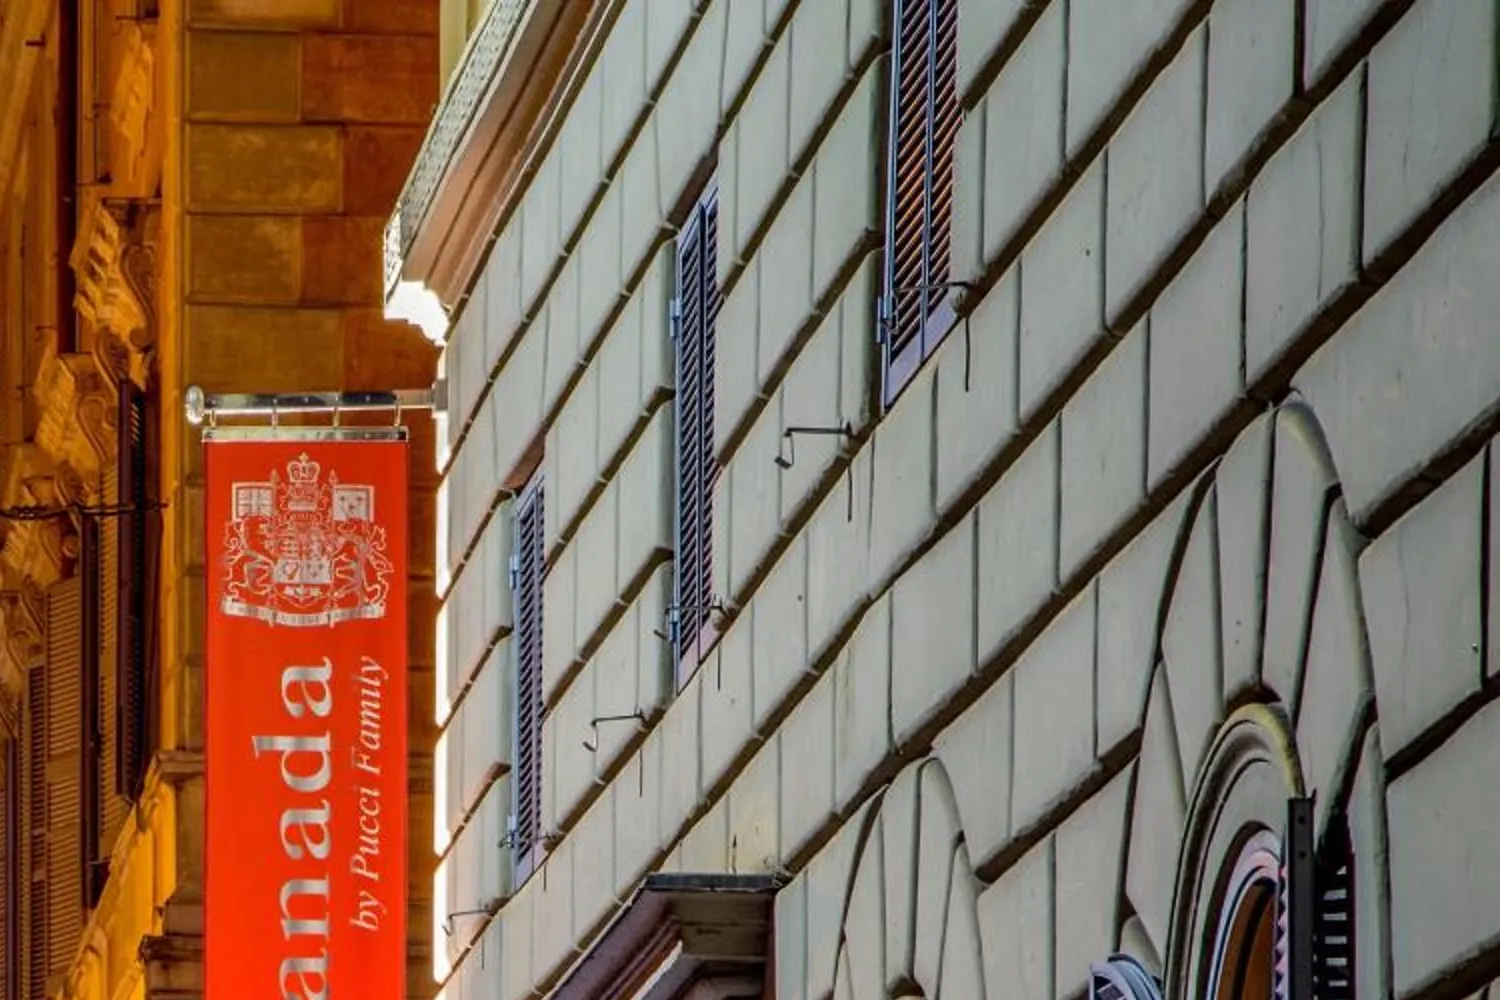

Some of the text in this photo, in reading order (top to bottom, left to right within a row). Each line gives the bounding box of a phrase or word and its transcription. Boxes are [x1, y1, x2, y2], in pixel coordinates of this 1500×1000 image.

[350, 655, 389, 932] by Pucci Family
